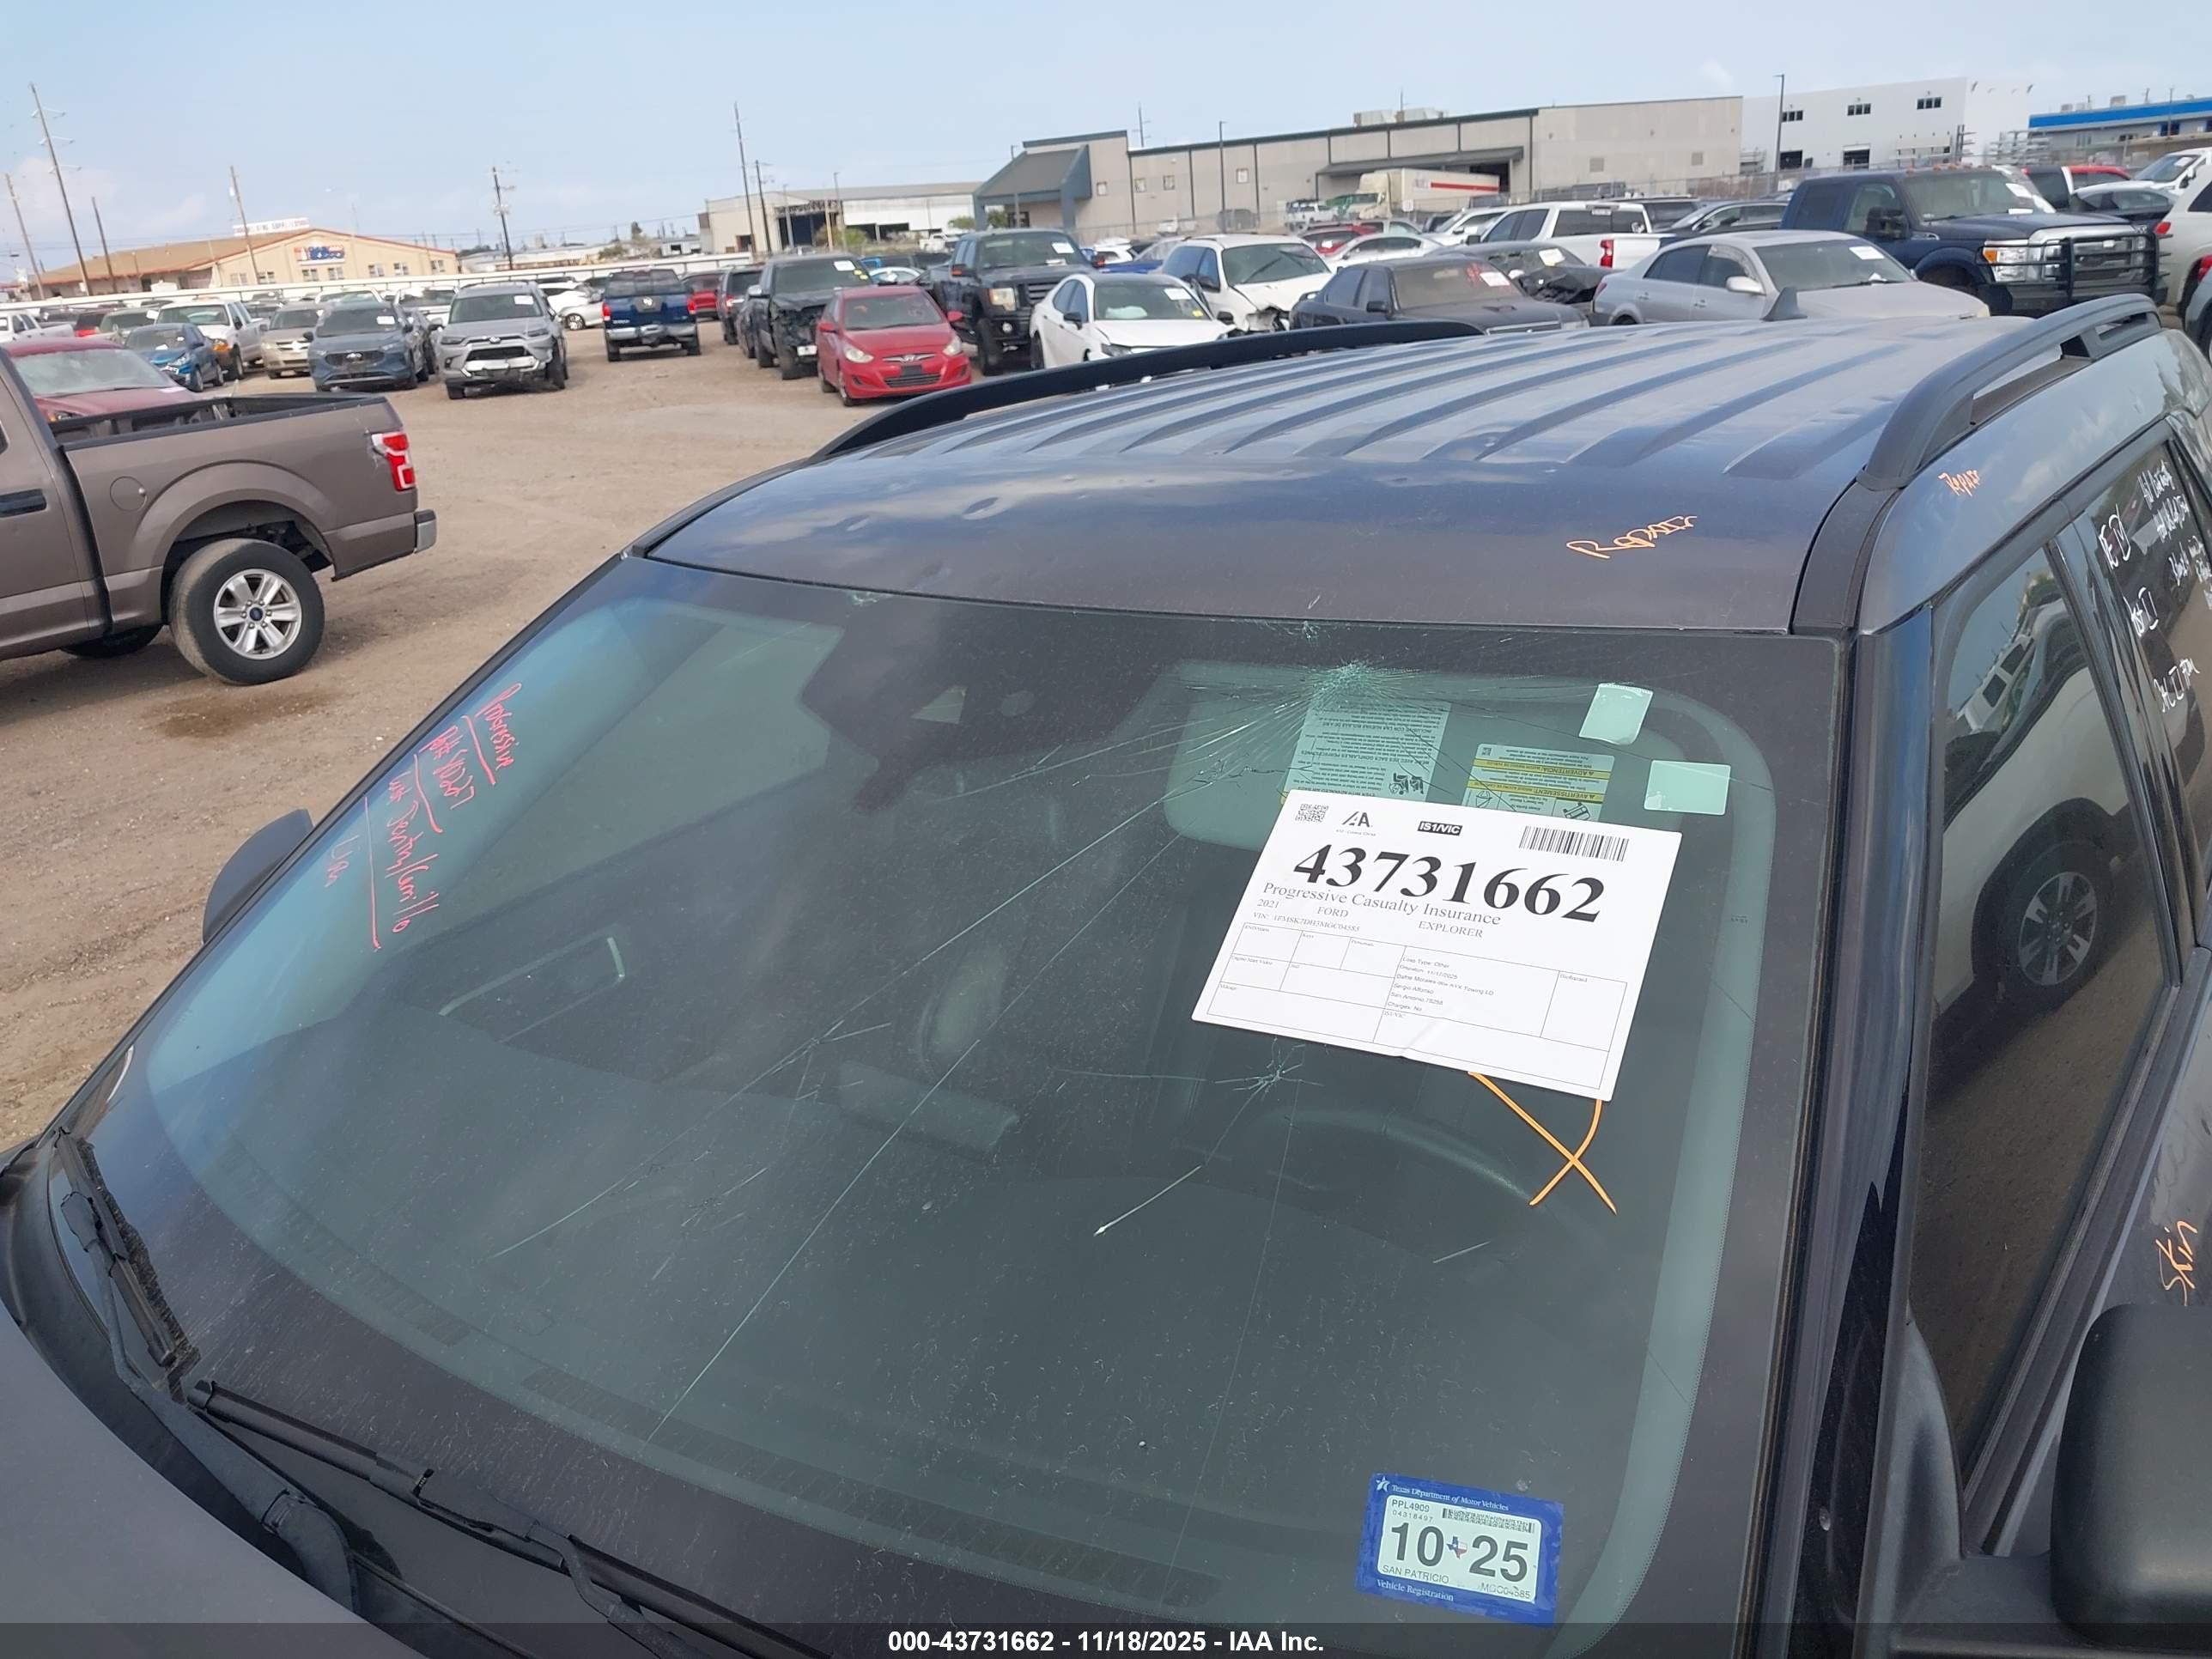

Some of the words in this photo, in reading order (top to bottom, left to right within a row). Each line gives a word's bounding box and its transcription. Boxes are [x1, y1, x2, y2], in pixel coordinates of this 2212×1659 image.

[1293, 844, 1605, 923] 43731662
[1256, 898, 1280, 909] 2021
[1263, 882, 1347, 903] Progressive
[1352, 893, 1419, 916] Casualty
[1423, 902, 1501, 926] Insurance
[1316, 906, 1349, 918] FORD
[1419, 921, 1484, 939] EXPLORER
[1391, 1485, 1410, 1494] Texas
[1411, 1488, 1451, 1502] Department
[1451, 1495, 1460, 1504] of
[1461, 1497, 1481, 1506] Motor
[1481, 1499, 1510, 1511] Vehicles
[1391, 1522, 1444, 1567] 10
[1469, 1535, 1528, 1583] 25
[1382, 1565, 1402, 1576] SAN
[1404, 1568, 1449, 1584] PATRICIO
[1376, 1579, 1406, 1593] Vehicle
[1407, 1584, 1455, 1602] Registration
